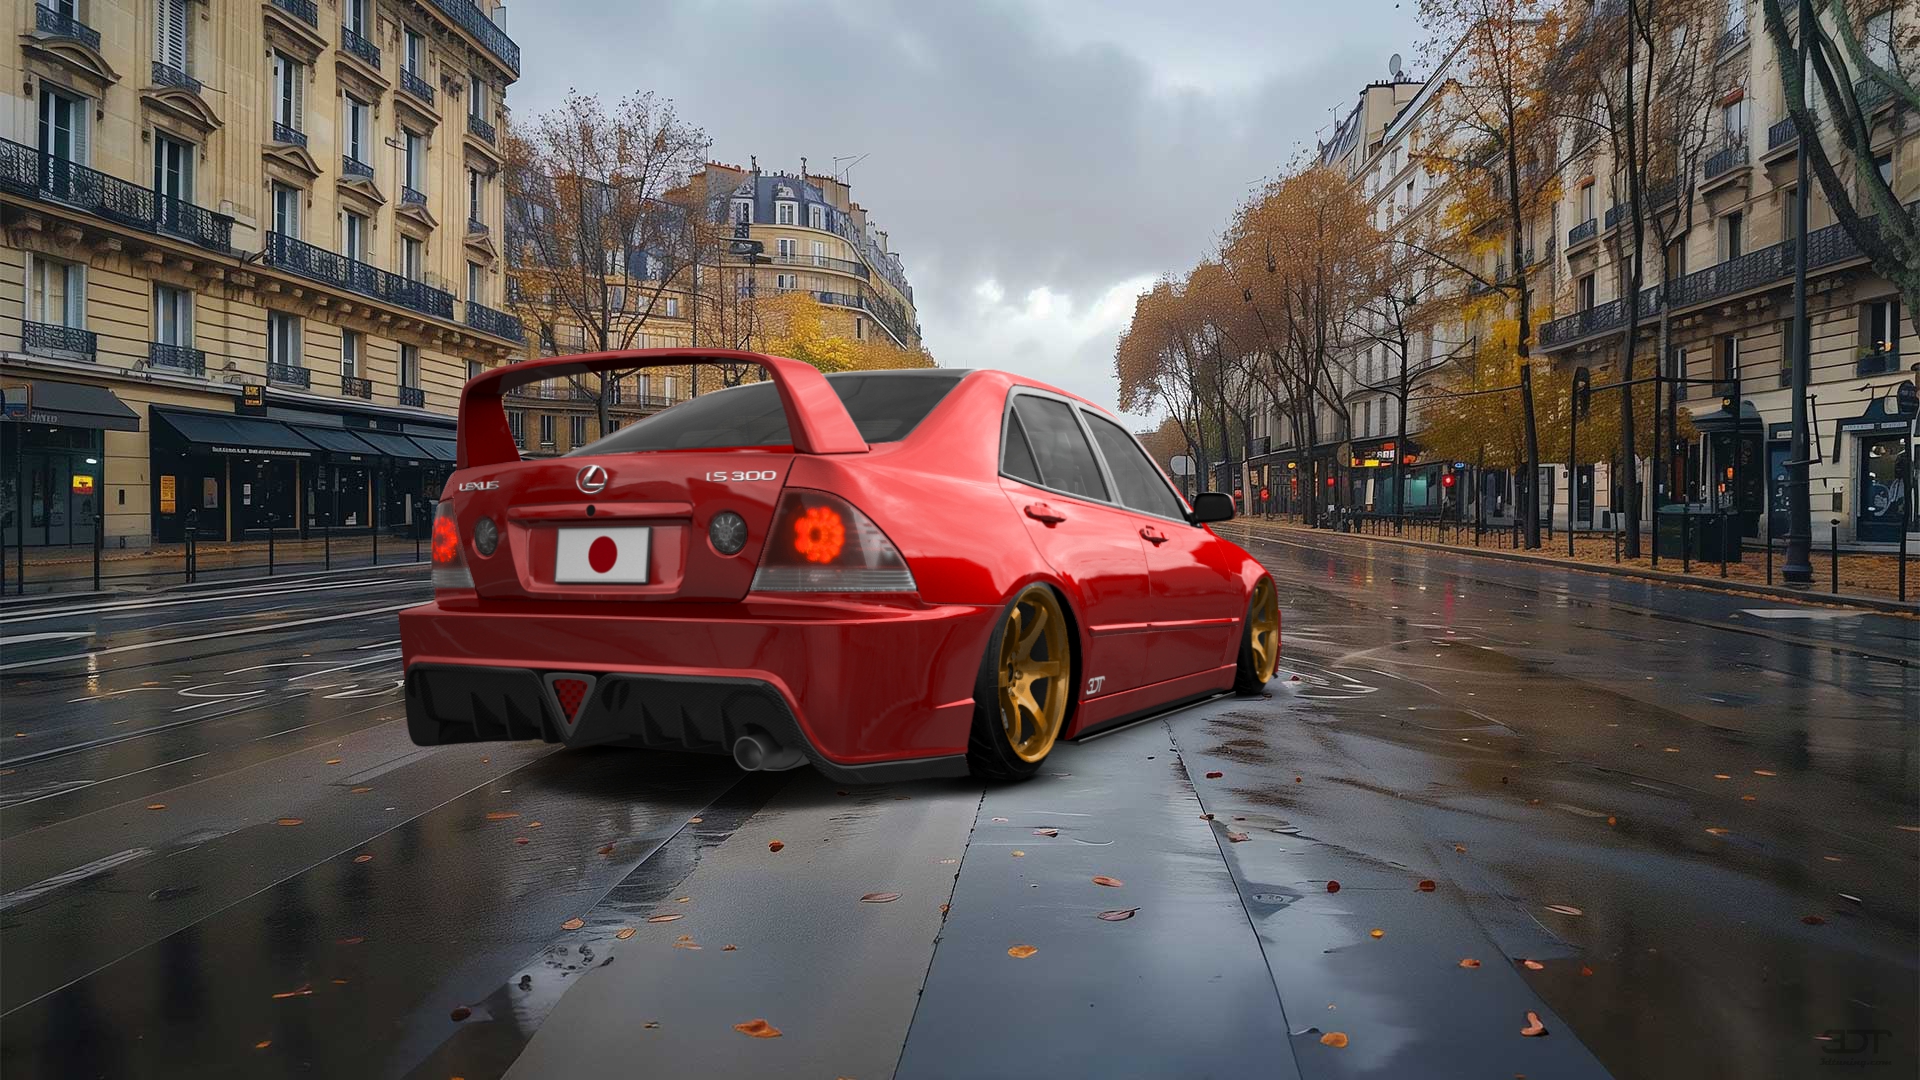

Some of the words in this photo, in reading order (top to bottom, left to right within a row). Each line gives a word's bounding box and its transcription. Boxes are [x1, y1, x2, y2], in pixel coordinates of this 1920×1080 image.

[731, 470, 777, 482] 300
[459, 481, 499, 491] LEXUS
[1086, 675, 1106, 695] 3DT
